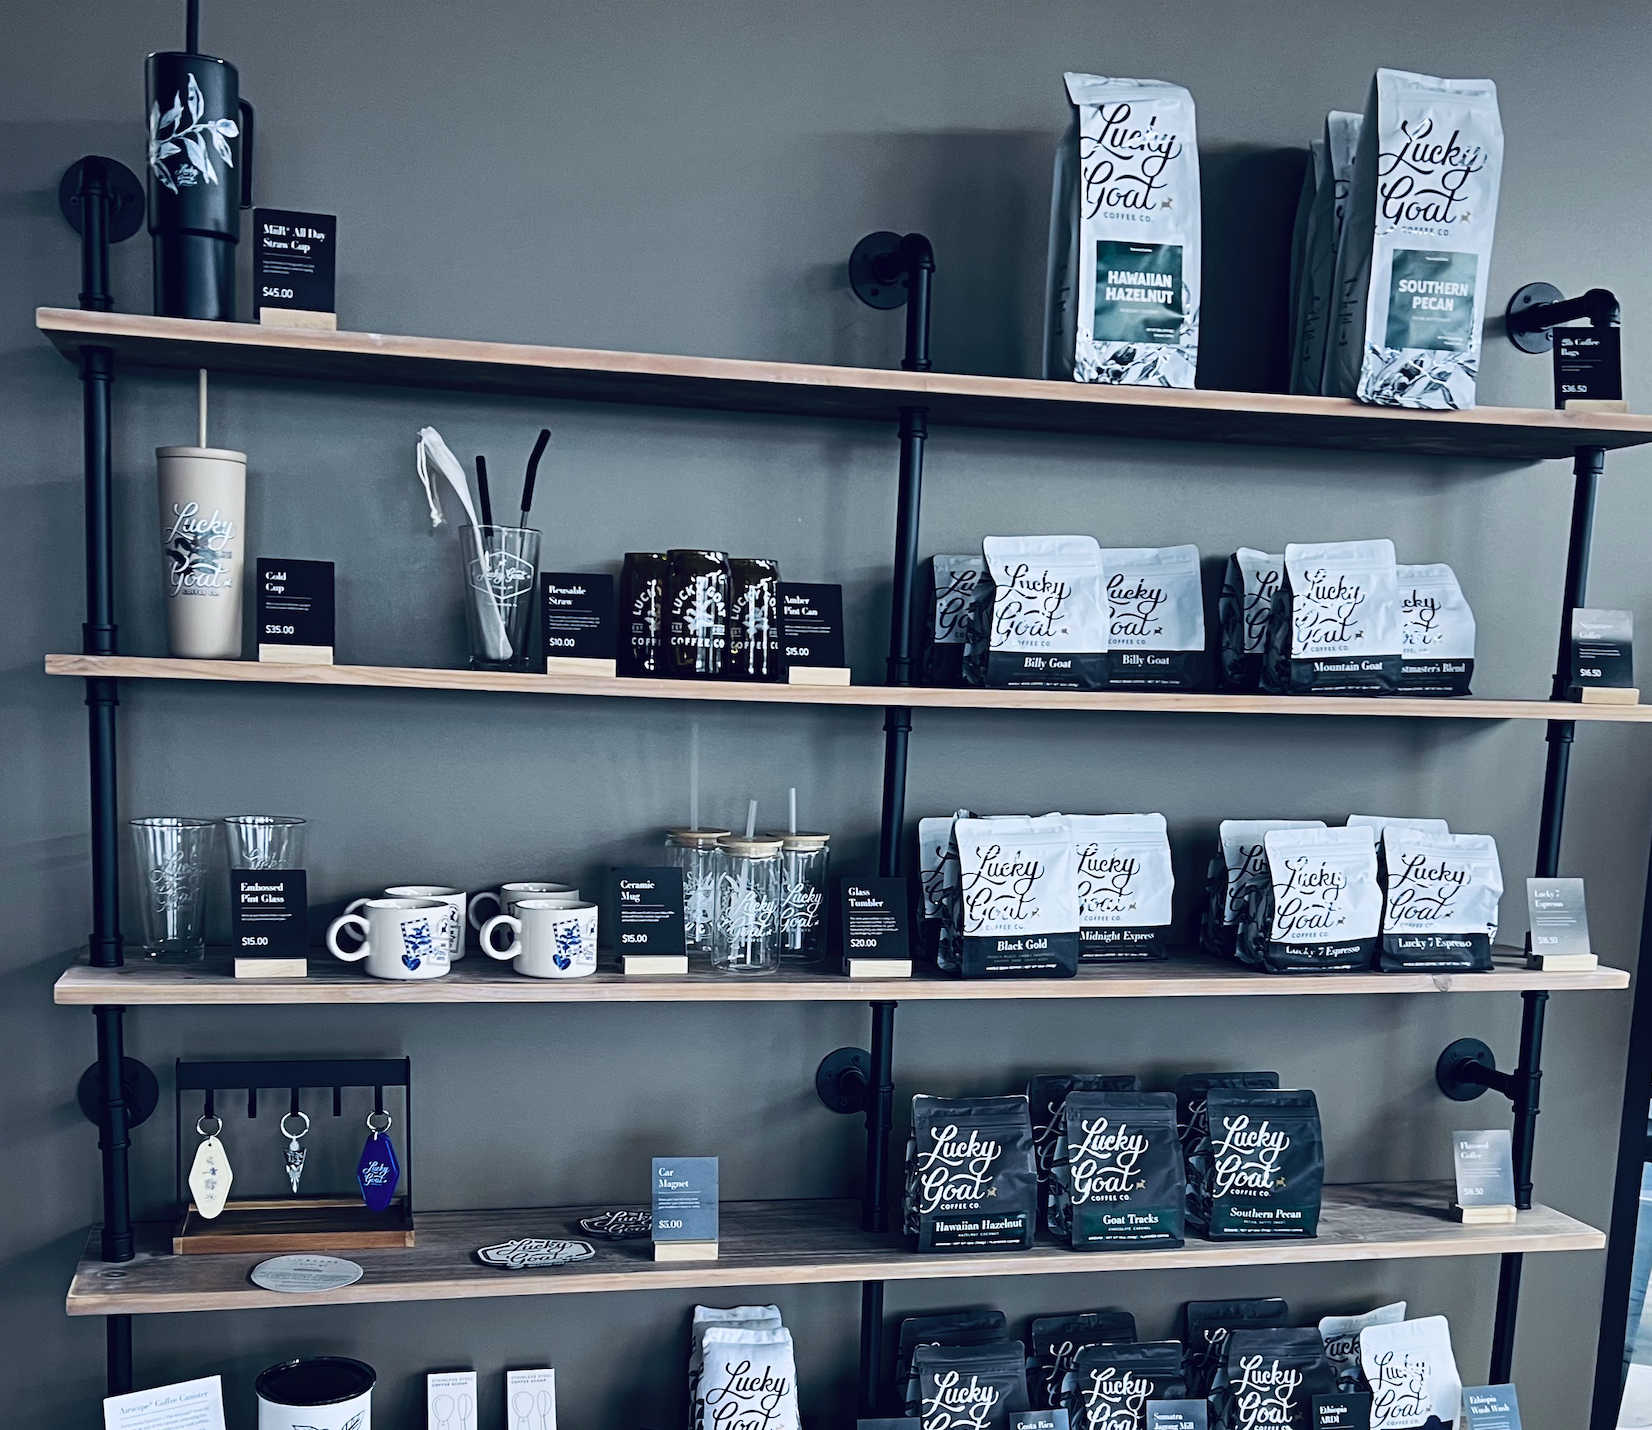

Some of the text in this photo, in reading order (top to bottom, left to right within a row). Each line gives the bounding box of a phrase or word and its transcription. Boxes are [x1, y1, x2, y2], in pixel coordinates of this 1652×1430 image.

[1080, 104, 1182, 177] Lucky
[1378, 118, 1487, 191] Lucky
[1082, 161, 1168, 219] Goat
[1375, 175, 1468, 236] Goat
[1103, 211, 1136, 221] COFFEE
[292, 227, 306, 238] All
[308, 229, 326, 242] Day
[263, 237, 311, 254] Straw Cup
[1107, 270, 1172, 288] HAWAIIAN
[262, 286, 294, 299] $45.00
[1398, 279, 1469, 297] SOUTHERN
[1105, 286, 1174, 305] HAZELNUT
[1412, 295, 1454, 312] PECAN
[1562, 384, 1588, 393] $36.50
[164, 502, 235, 551] Lucky
[169, 555, 230, 597] Goat
[265, 571, 287, 581] Cold
[265, 582, 285, 594] Cup
[548, 585, 587, 596] Reusable
[996, 564, 1071, 618] Lucky
[1107, 573, 1167, 616] Lucky
[1293, 568, 1366, 620] Lucky
[548, 596, 573, 606] Straw
[706, 586, 727, 617] GOAT
[783, 595, 810, 605] Amber
[783, 606, 818, 616] Pint Can
[265, 624, 295, 635] $35.00
[990, 601, 1064, 647] Goat
[1292, 610, 1358, 655] Goat
[549, 637, 575, 647] $10.00
[671, 637, 711, 648] COFFEE
[785, 647, 809, 657] $15.00
[1024, 657, 1071, 670] Billy Goat
[1122, 654, 1170, 666] Billy Goat
[1313, 660, 1383, 672] Mountain Goat
[1401, 662, 1466, 673] stmaster's Blend
[961, 844, 1045, 896] Lucky
[1076, 842, 1140, 888] Lucky
[1273, 856, 1347, 901] Lucky
[1388, 853, 1472, 900] Lucky
[240, 882, 284, 892] Embossed
[620, 879, 655, 890] Ceramic
[620, 891, 641, 902] Mug
[848, 886, 871, 897] Glass
[240, 894, 285, 903] Pint Glass
[781, 883, 823, 916] Lucky
[848, 898, 884, 908] Tumbler
[963, 887, 1036, 933] Goat
[1384, 889, 1456, 930] Goat
[779, 908, 818, 933] Goat
[1271, 898, 1341, 939] Goat
[241, 936, 268, 946] $15.00
[621, 933, 648, 944] $15.00
[850, 938, 877, 948] $20.00
[1079, 931, 1121, 943] Midnight
[1398, 937, 1472, 950] Lucky 7 Espresso
[997, 938, 1048, 952] Black Gold
[1318, 947, 1325, 956] 7
[1325, 945, 1361, 957] Espresso
[1068, 1116, 1149, 1169] Lucky
[1211, 1114, 1290, 1165] Lucky
[1460, 1141, 1489, 1150] Flavored
[917, 1124, 1001, 1177] Lucky
[1460, 1151, 1482, 1159] Coffee
[658, 1167, 674, 1177] Car
[1213, 1154, 1281, 1199] Goat
[658, 1179, 689, 1190] Magnet
[1071, 1159, 1141, 1205] Goat
[919, 1167, 993, 1214] Goat
[1230, 1188, 1257, 1196] COFFEE
[1091, 1194, 1117, 1202] COFFEE
[940, 1203, 967, 1211] COFFEE
[1230, 1207, 1302, 1219] Southern Pecan
[658, 1219, 683, 1229] $5.00
[935, 1218, 1023, 1233] Hawaiian Hazelnut
[1102, 1213, 1159, 1225] Goat Tracks
[496, 1239, 573, 1254] Lucky
[506, 1253, 561, 1264] Goat
[1230, 1354, 1303, 1401] Lucky
[706, 1360, 790, 1411] Lucky
[1081, 1367, 1154, 1412] Lucky
[155, 1397, 178, 1407] Coffee
[179, 1391, 208, 1402] Canister
[922, 1370, 999, 1420] Lucky
[1469, 1395, 1497, 1405] Ethiopia
[1235, 1391, 1297, 1430] Goat
[1319, 1405, 1348, 1415] Ethiopia
[1370, 1389, 1428, 1429] Goat
[1470, 1403, 1510, 1414] Wush Wush
[1153, 1413, 1183, 1421] Sumatra
[1319, 1415, 1340, 1424] ARDI
[1017, 1421, 1054, 1430] Costa Rica
